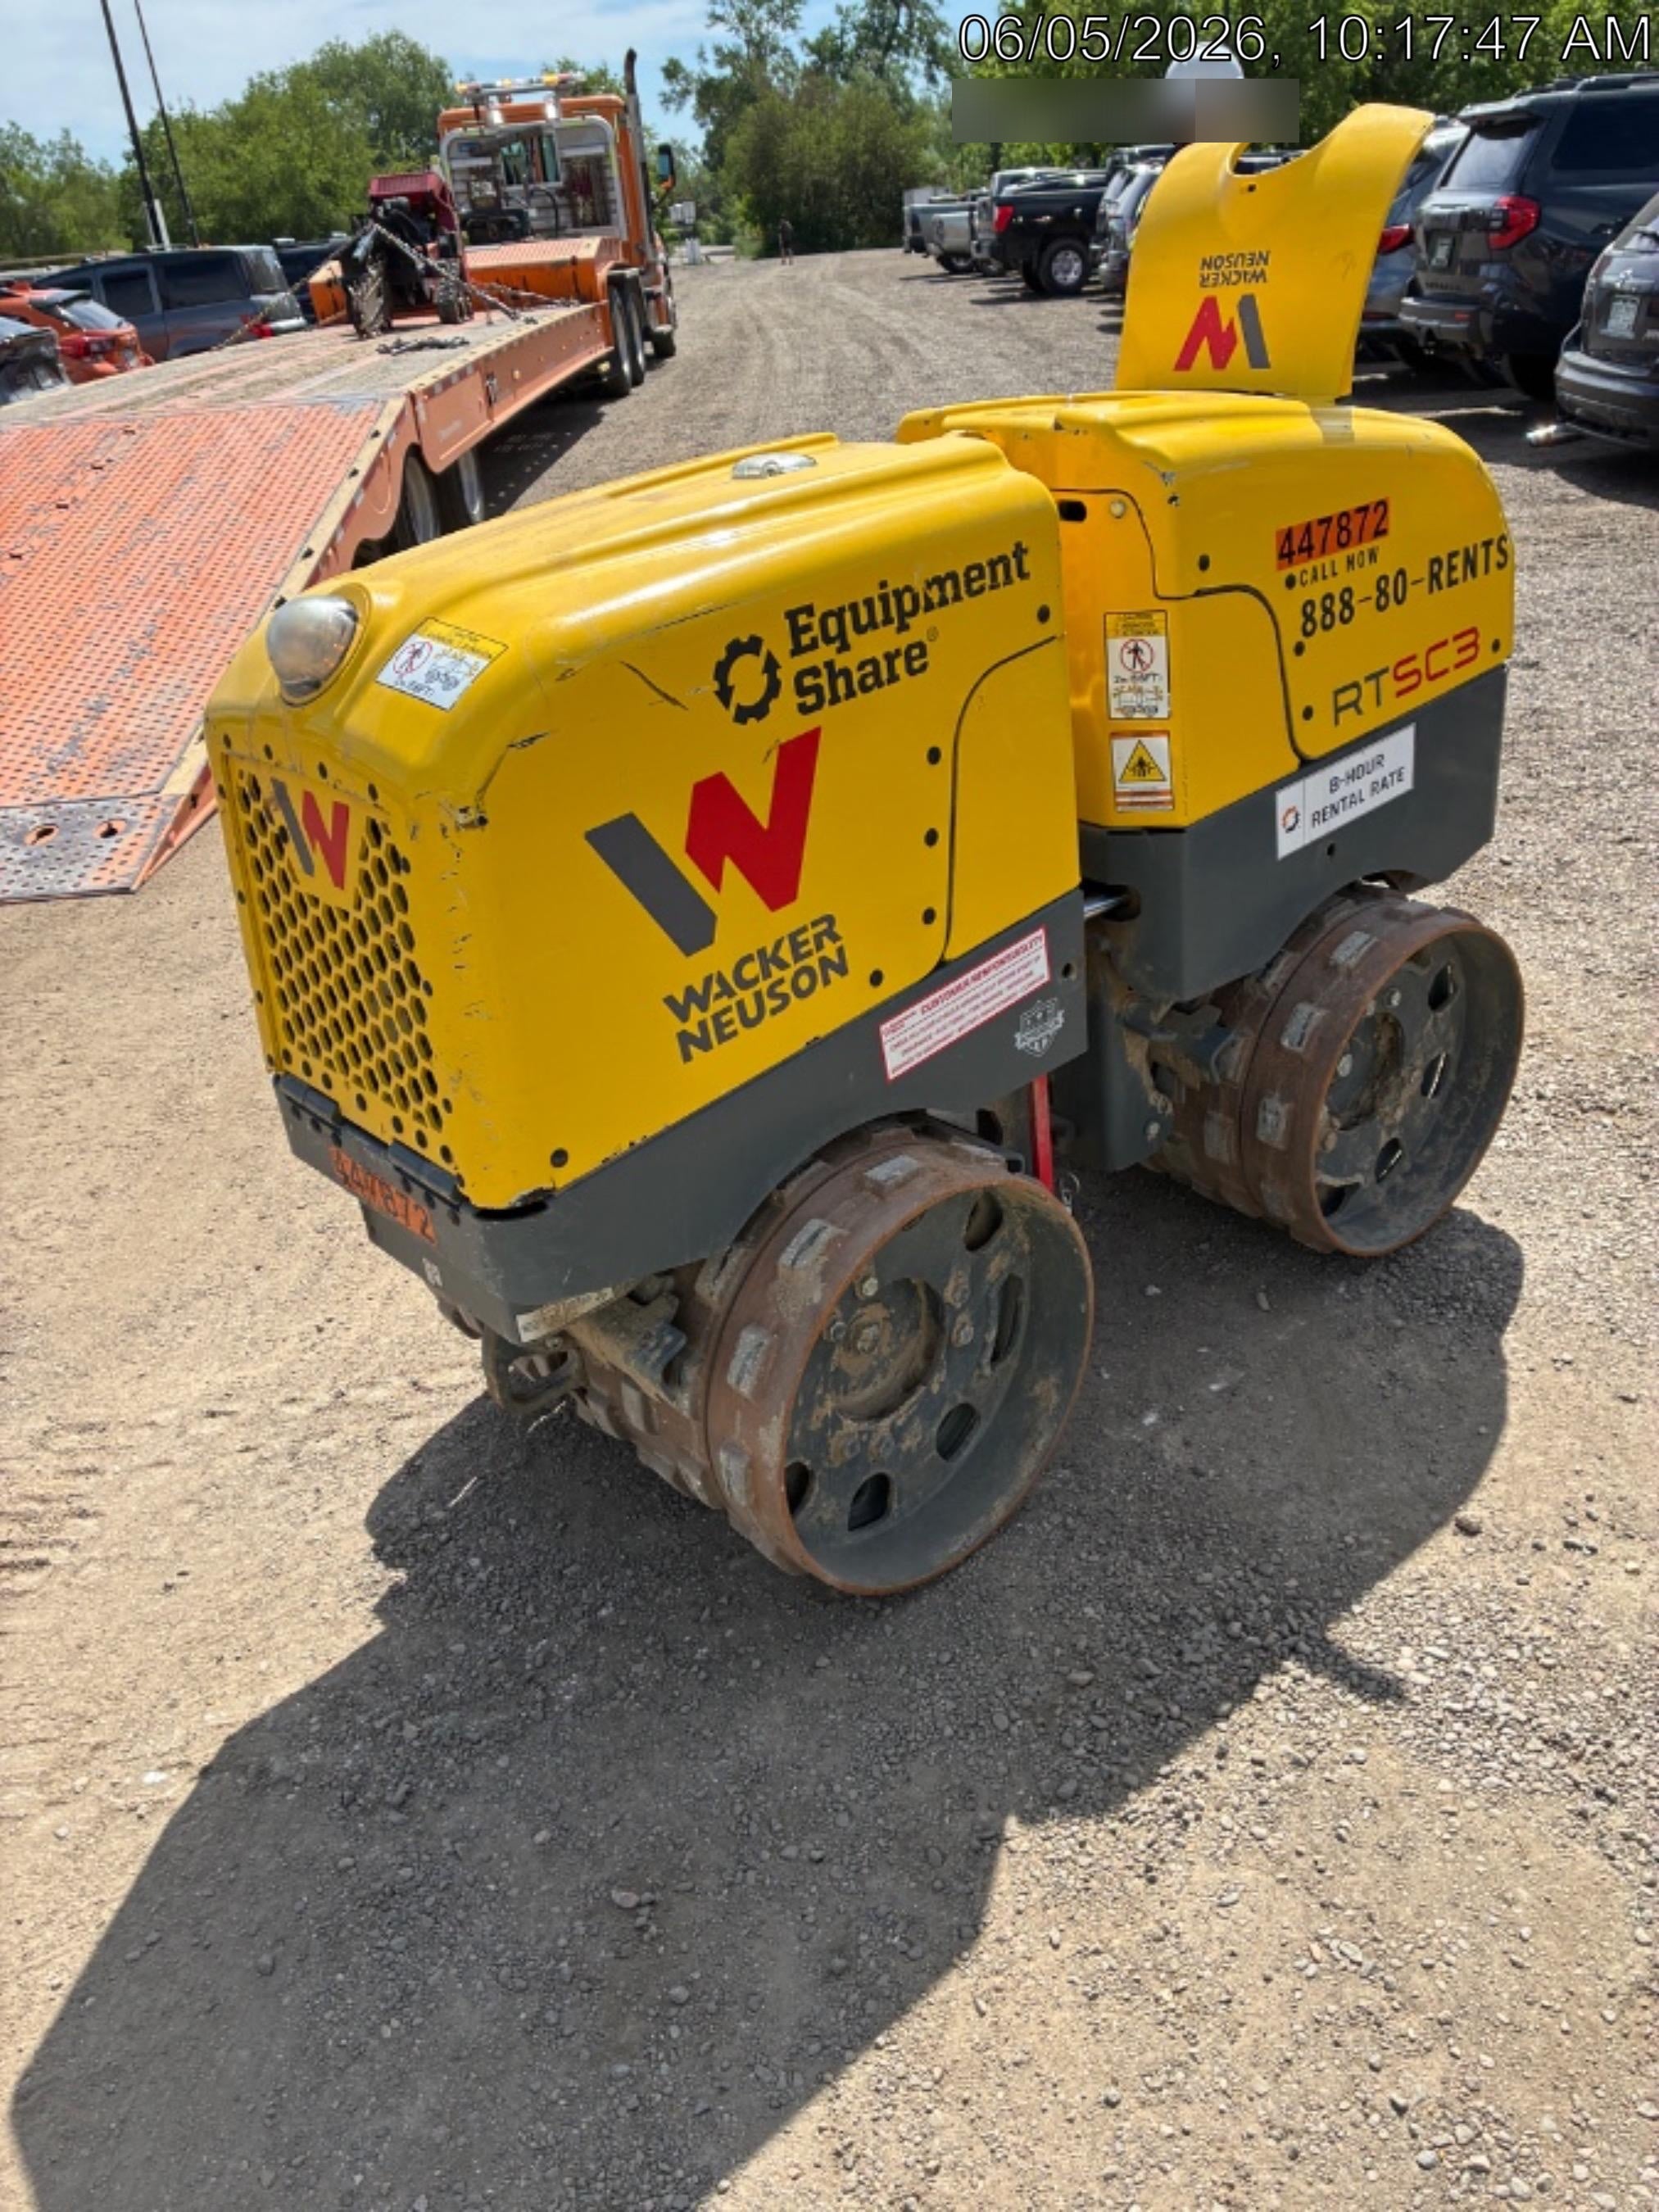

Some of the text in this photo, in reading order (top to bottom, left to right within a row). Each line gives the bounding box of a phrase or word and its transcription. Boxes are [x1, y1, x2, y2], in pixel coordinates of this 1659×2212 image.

[1199, 268, 1267, 288] WACKER
[1200, 250, 1271, 271] NEUSON
[1277, 498, 1389, 564] 447872
[1299, 546, 1380, 587] CALL NOW
[783, 540, 1030, 658] Equipment
[1300, 533, 1510, 638] 888-80-RENTS
[1331, 626, 1480, 727] RTSC3
[1312, 765, 1406, 828] RENTAL RATE
[662, 913, 843, 1024] WACKER
[675, 945, 850, 1065] NEUSON
